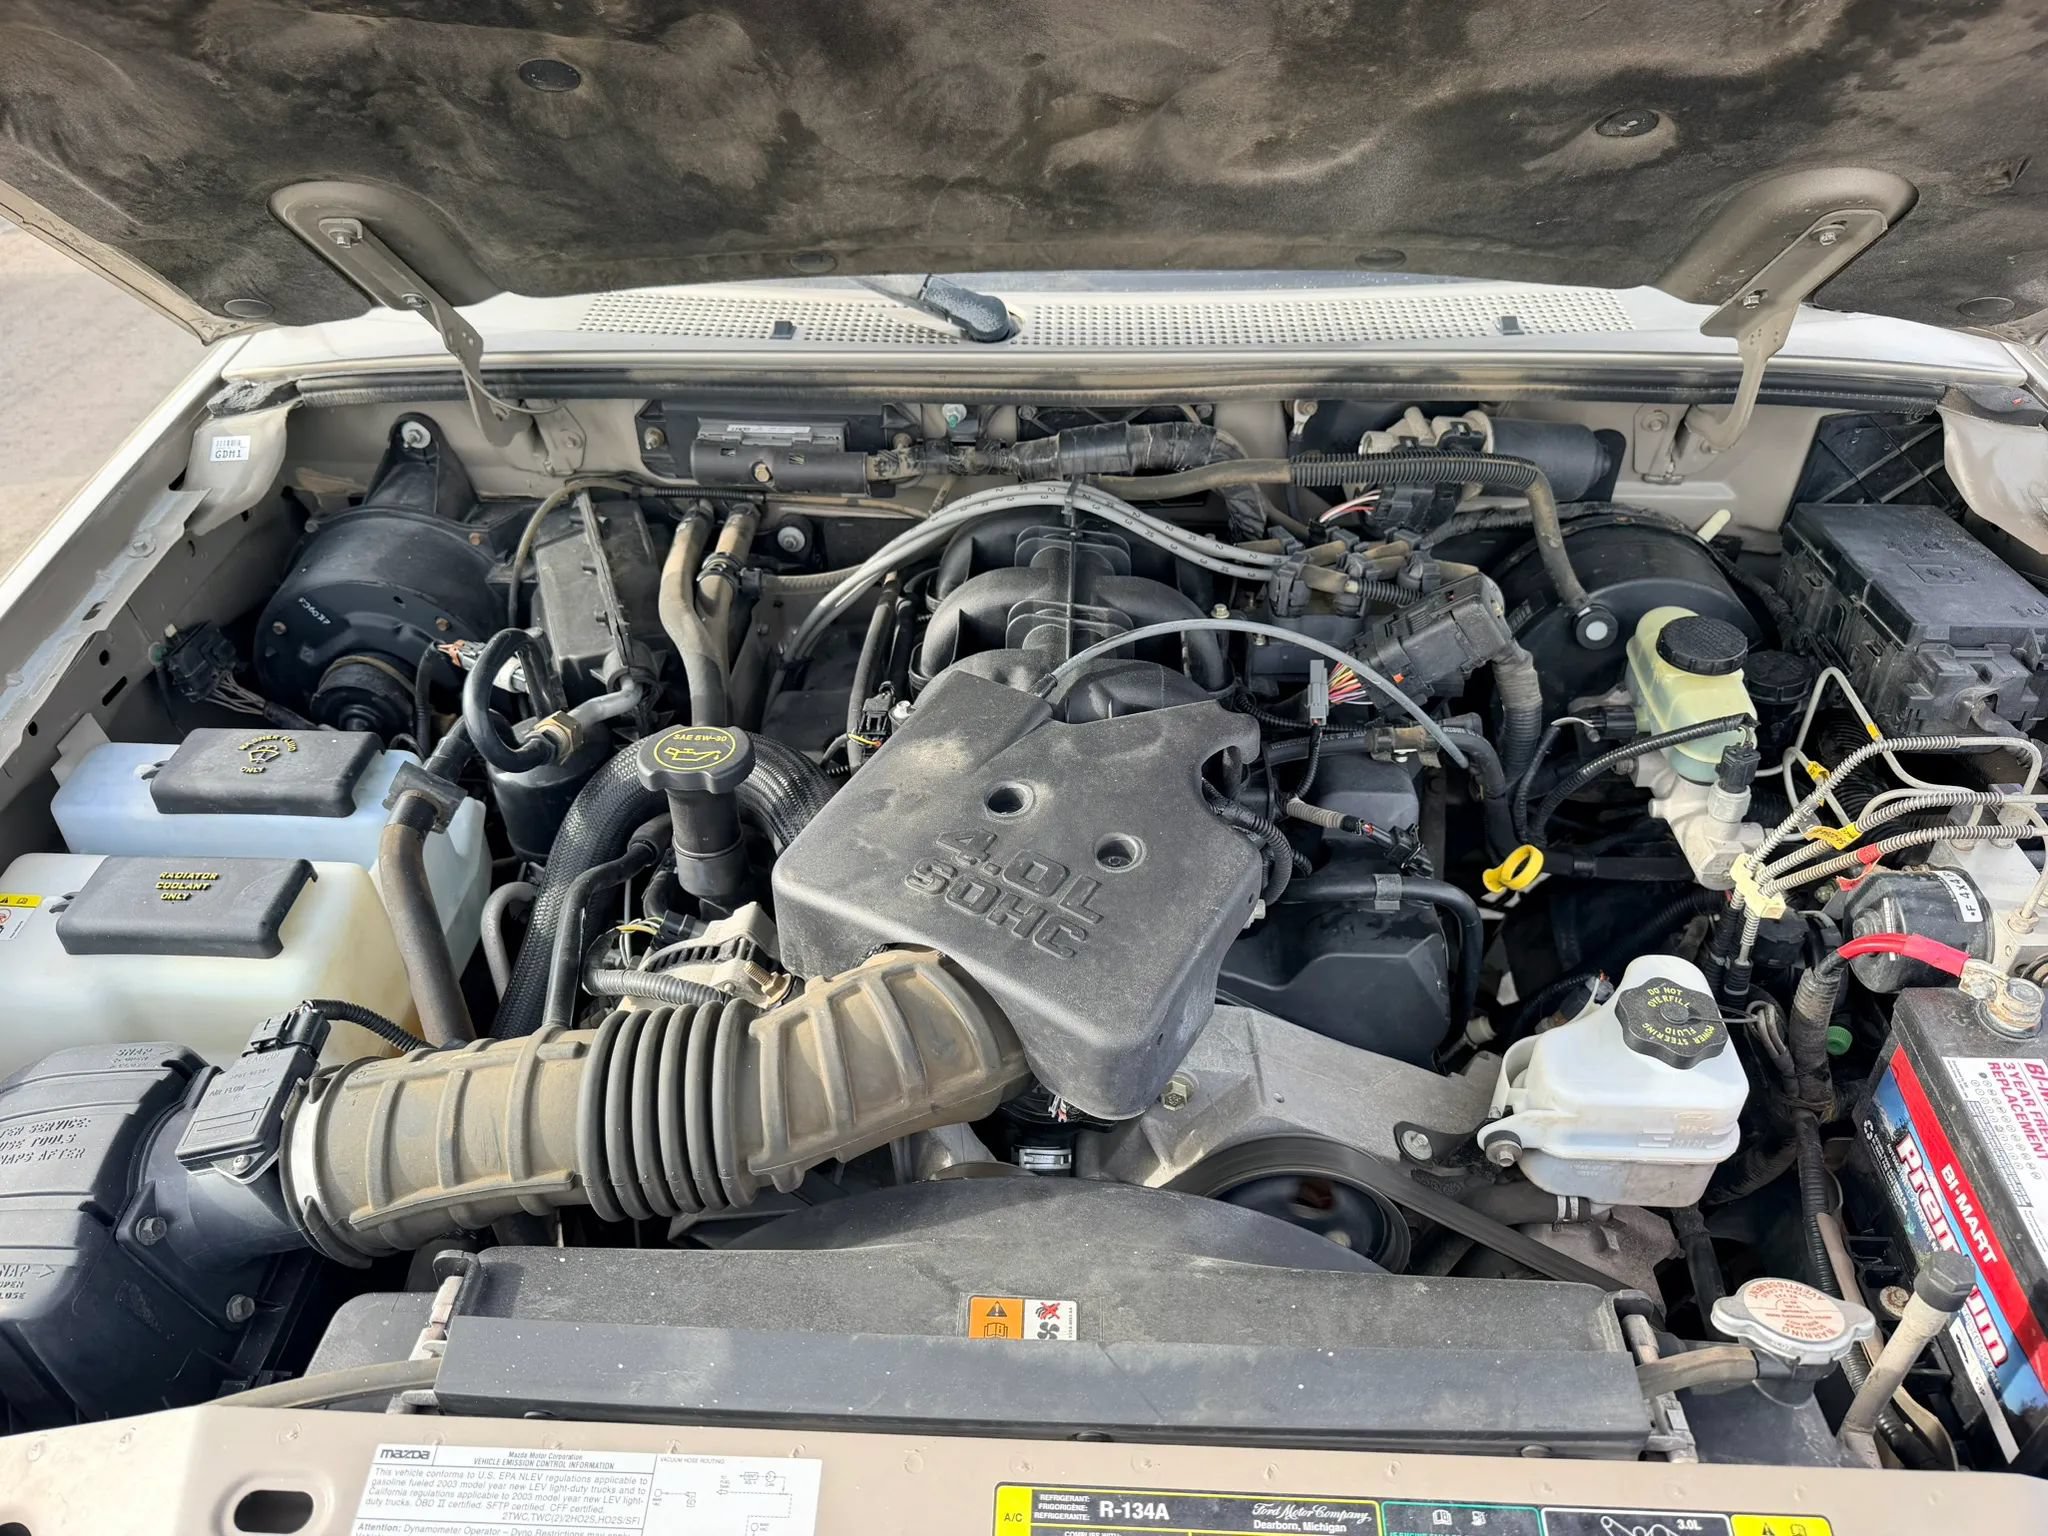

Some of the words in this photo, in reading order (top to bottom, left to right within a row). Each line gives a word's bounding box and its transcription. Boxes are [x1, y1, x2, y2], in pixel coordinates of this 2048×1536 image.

[694, 734, 728, 742] 5W-30
[240, 766, 266, 774] ONLY
[159, 871, 219, 880] RADIATOR
[934, 826, 1107, 926] 4.0L
[155, 881, 211, 890] COOLANT
[160, 892, 191, 901] ONLY
[903, 856, 1095, 962] SOHC
[1646, 987, 1660, 996] DO
[1663, 986, 1683, 996] NOT
[1647, 994, 1690, 1009] OVERFILL
[1641, 1022, 1689, 1046] STEERING
[1664, 1026, 1697, 1037] FLUID
[1692, 1024, 1715, 1045] POWER
[2003, 1062, 2016, 1070] 3
[2009, 1072, 2036, 1107] YEAR
[2024, 1062, 2048, 1107] BI-M
[1988, 1062, 2048, 1161] REPLACEMENT
[30, 1134, 76, 1148] TOOLS
[0, 1152, 34, 1165] NAPS
[38, 1148, 86, 1161] AFTER
[1940, 1163, 1998, 1264] BI-MART
[1896, 1132, 2009, 1368] Premum
[0, 1264, 31, 1278] NAP
[508, 1451, 528, 1459] Mazda
[530, 1452, 547, 1460] Motor
[548, 1452, 583, 1461] Corporation
[473, 1458, 500, 1466] VEHICLE
[502, 1458, 534, 1468] EMISSION
[536, 1460, 566, 1468] CONTROL
[568, 1460, 615, 1470] INFORMATION
[375, 1468, 392, 1476] This
[394, 1468, 424, 1478] vehicle
[426, 1470, 464, 1479] conforms
[466, 1471, 476, 1480] to
[478, 1471, 496, 1480] U.S.
[498, 1472, 516, 1480] EPA
[518, 1472, 544, 1481] NLEV
[545, 1474, 592, 1485] regulations
[594, 1475, 637, 1486] applicable
[640, 1476, 648, 1485] to
[371, 1478, 406, 1488] gasoline
[408, 1479, 434, 1488] fueled
[436, 1480, 458, 1488] 2003
[460, 1480, 486, 1489] model
[488, 1483, 506, 1491] year
[528, 1482, 548, 1492] LEV
[550, 1484, 589, 1494] light-duty
[591, 1485, 616, 1494] trucks
[619, 1486, 636, 1494] and
[638, 1486, 646, 1495] to
[368, 1486, 408, 1496] California
[409, 1488, 455, 1498] regulations
[457, 1490, 500, 1500] applicable
[501, 1492, 510, 1500] to
[512, 1492, 534, 1500] 2003
[535, 1492, 560, 1502] model
[562, 1495, 582, 1504] year
[602, 1496, 622, 1504] LEV
[622, 1496, 644, 1506] light-
[1040, 1494, 1090, 1502] REFRIGERANT:
[365, 1497, 383, 1506] duty
[415, 1498, 434, 1508] OBD
[486, 1501, 510, 1510] SFTP
[550, 1504, 568, 1512] CFF
[1038, 1502, 1088, 1512] FRIGORIGÈNE:
[1100, 1500, 1170, 1521] R-134A
[1004, 1513, 1023, 1522] A/C
[1034, 1512, 1091, 1521] REFRIGERANTE:
[1252, 1502, 1281, 1516] Ford
[1276, 1504, 1314, 1520] Motor
[1312, 1504, 1372, 1524] Company
[358, 1522, 401, 1533] Attention:
[404, 1524, 462, 1536] Dynamometer
[464, 1526, 502, 1536] Operator
[1253, 1520, 1302, 1532] Dearborn,
[1303, 1522, 1347, 1534] Michigan
[1676, 1518, 1702, 1530] 3.0L
